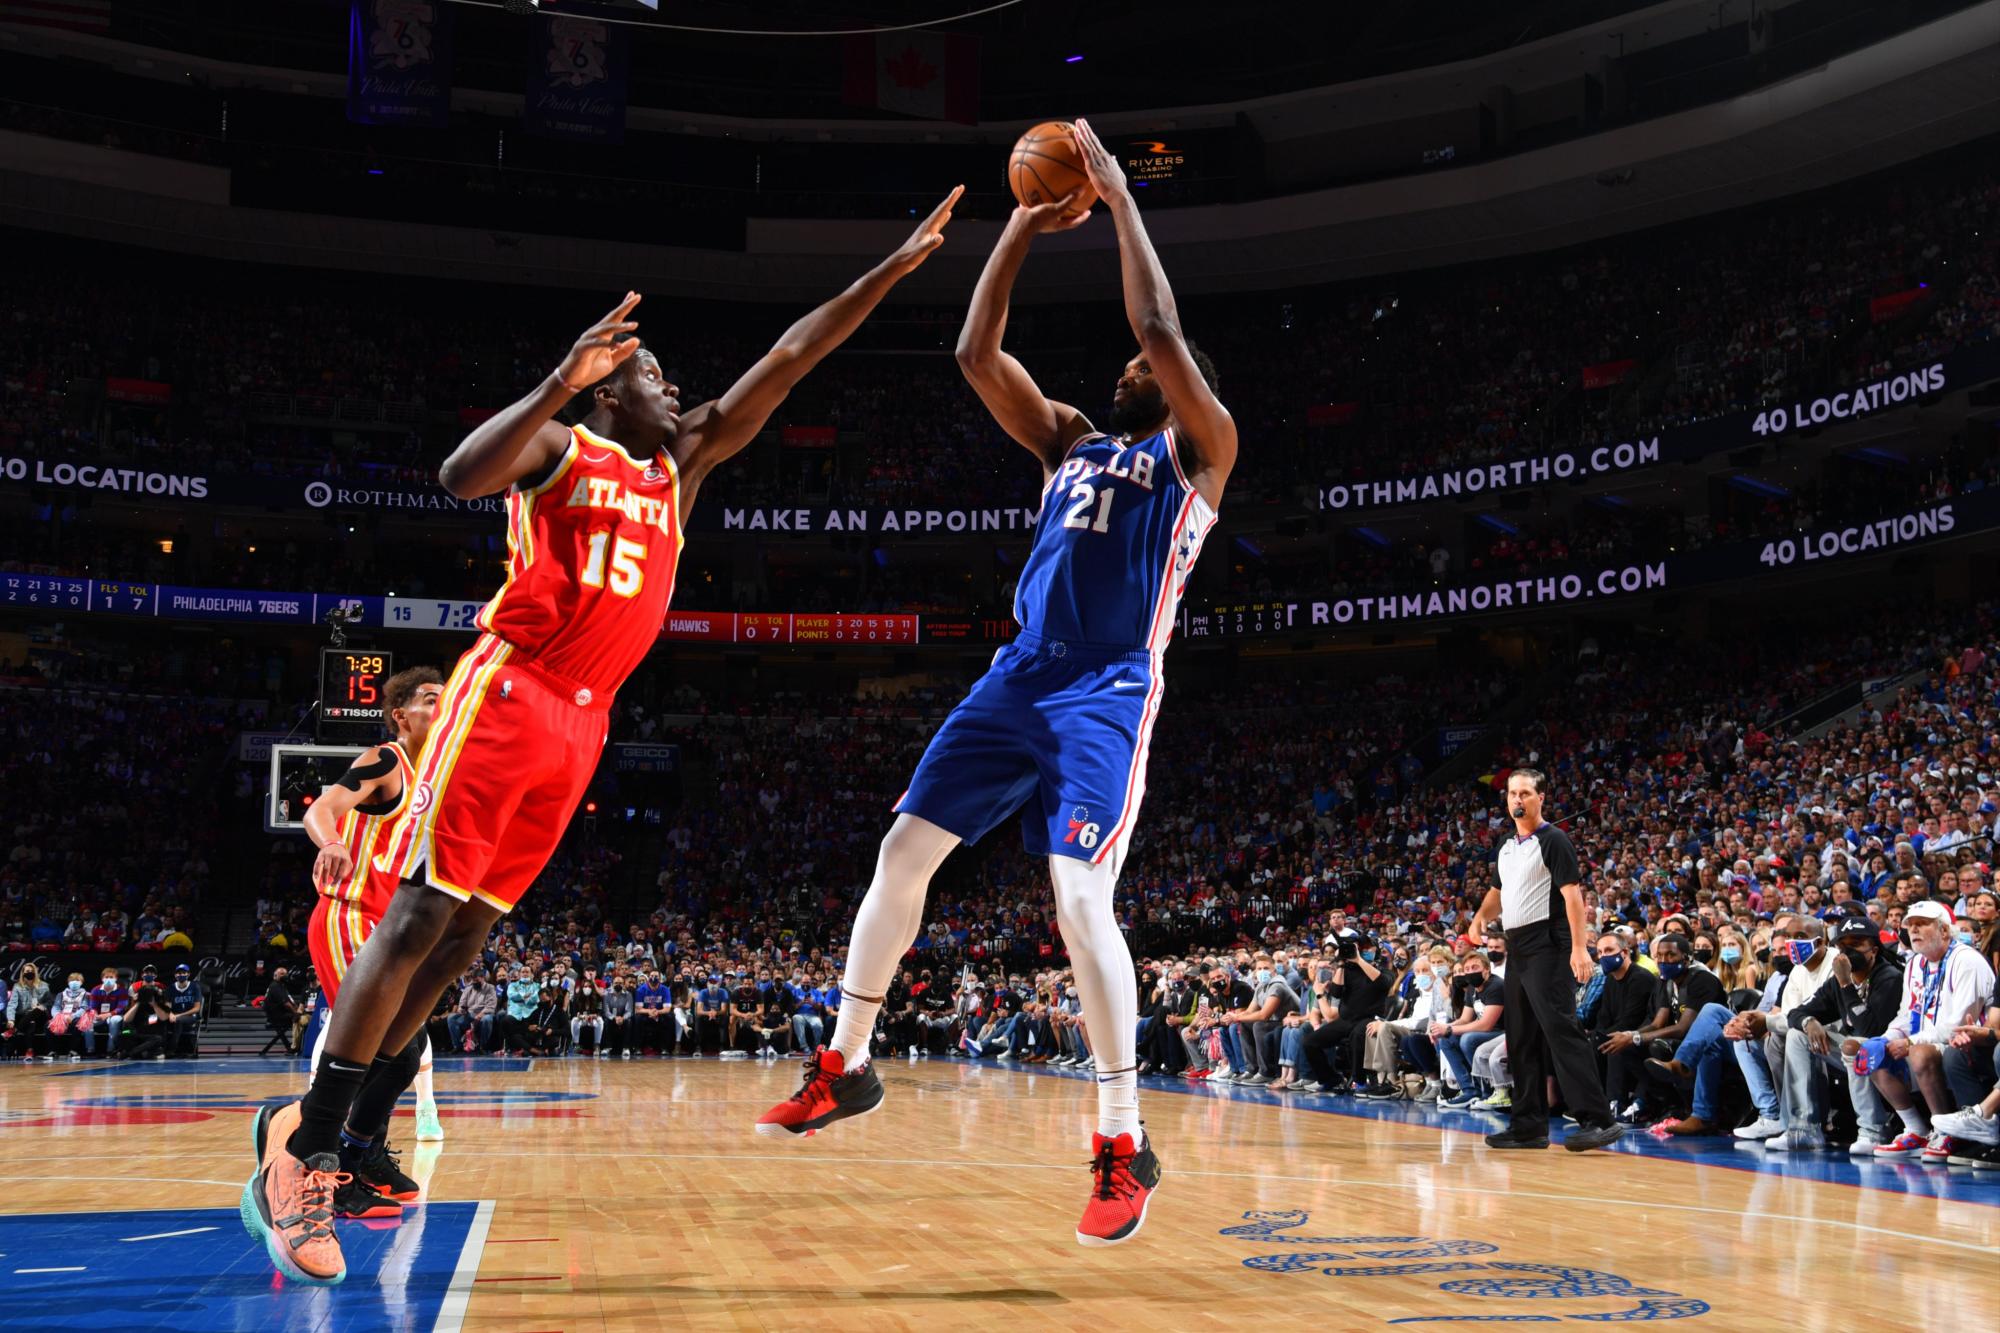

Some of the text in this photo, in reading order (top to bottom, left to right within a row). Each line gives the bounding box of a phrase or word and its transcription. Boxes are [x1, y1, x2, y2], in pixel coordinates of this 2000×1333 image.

[1129, 156, 1184, 168] RIVERS
[1752, 363, 1945, 436] 40 LOCATIONS
[35, 460, 208, 499] LOCATIONS
[337, 489, 459, 511] ROTHMAN
[567, 476, 669, 537] ATLNTA
[1064, 484, 1115, 534] 21
[724, 508, 810, 530] MAKE
[825, 510, 868, 530] AN
[1760, 505, 1955, 566] 40 LOCATIONS
[581, 530, 648, 598] 15
[8, 578, 82, 592] 12 21 31 25
[101, 584, 148, 596] FLS TOL
[1312, 562, 1666, 625] ROTHMANORTHO.COM
[8, 592, 79, 605] 2 6 3 0
[105, 596, 143, 610] 1 7
[173, 595, 300, 615] PHILADELPHIA 76ERS
[393, 604, 486, 628] 15 7:2
[744, 616, 784, 625] FLS TOL
[796, 619, 910, 628] PLAYER 3 20 15 13 11
[1192, 610, 1281, 626] PHI 3 3 1 0
[670, 619, 710, 633] HAWKS
[746, 626, 780, 639] 0 7
[1192, 622, 1281, 636] ATL 1 0 0 0
[797, 630, 830, 639] POINTS
[836, 631, 843, 639] 0
[853, 631, 860, 640] 2
[869, 631, 876, 640] 0
[886, 632, 892, 640] 2
[346, 656, 383, 674] 7:29
[348, 674, 376, 704] 15
[342, 708, 384, 718] TISSOT
[1446, 730, 1485, 742] GEI
[623, 748, 670, 758] GEICO
[1064, 818, 1100, 849] 76
[9, 956, 62, 980] Uite
